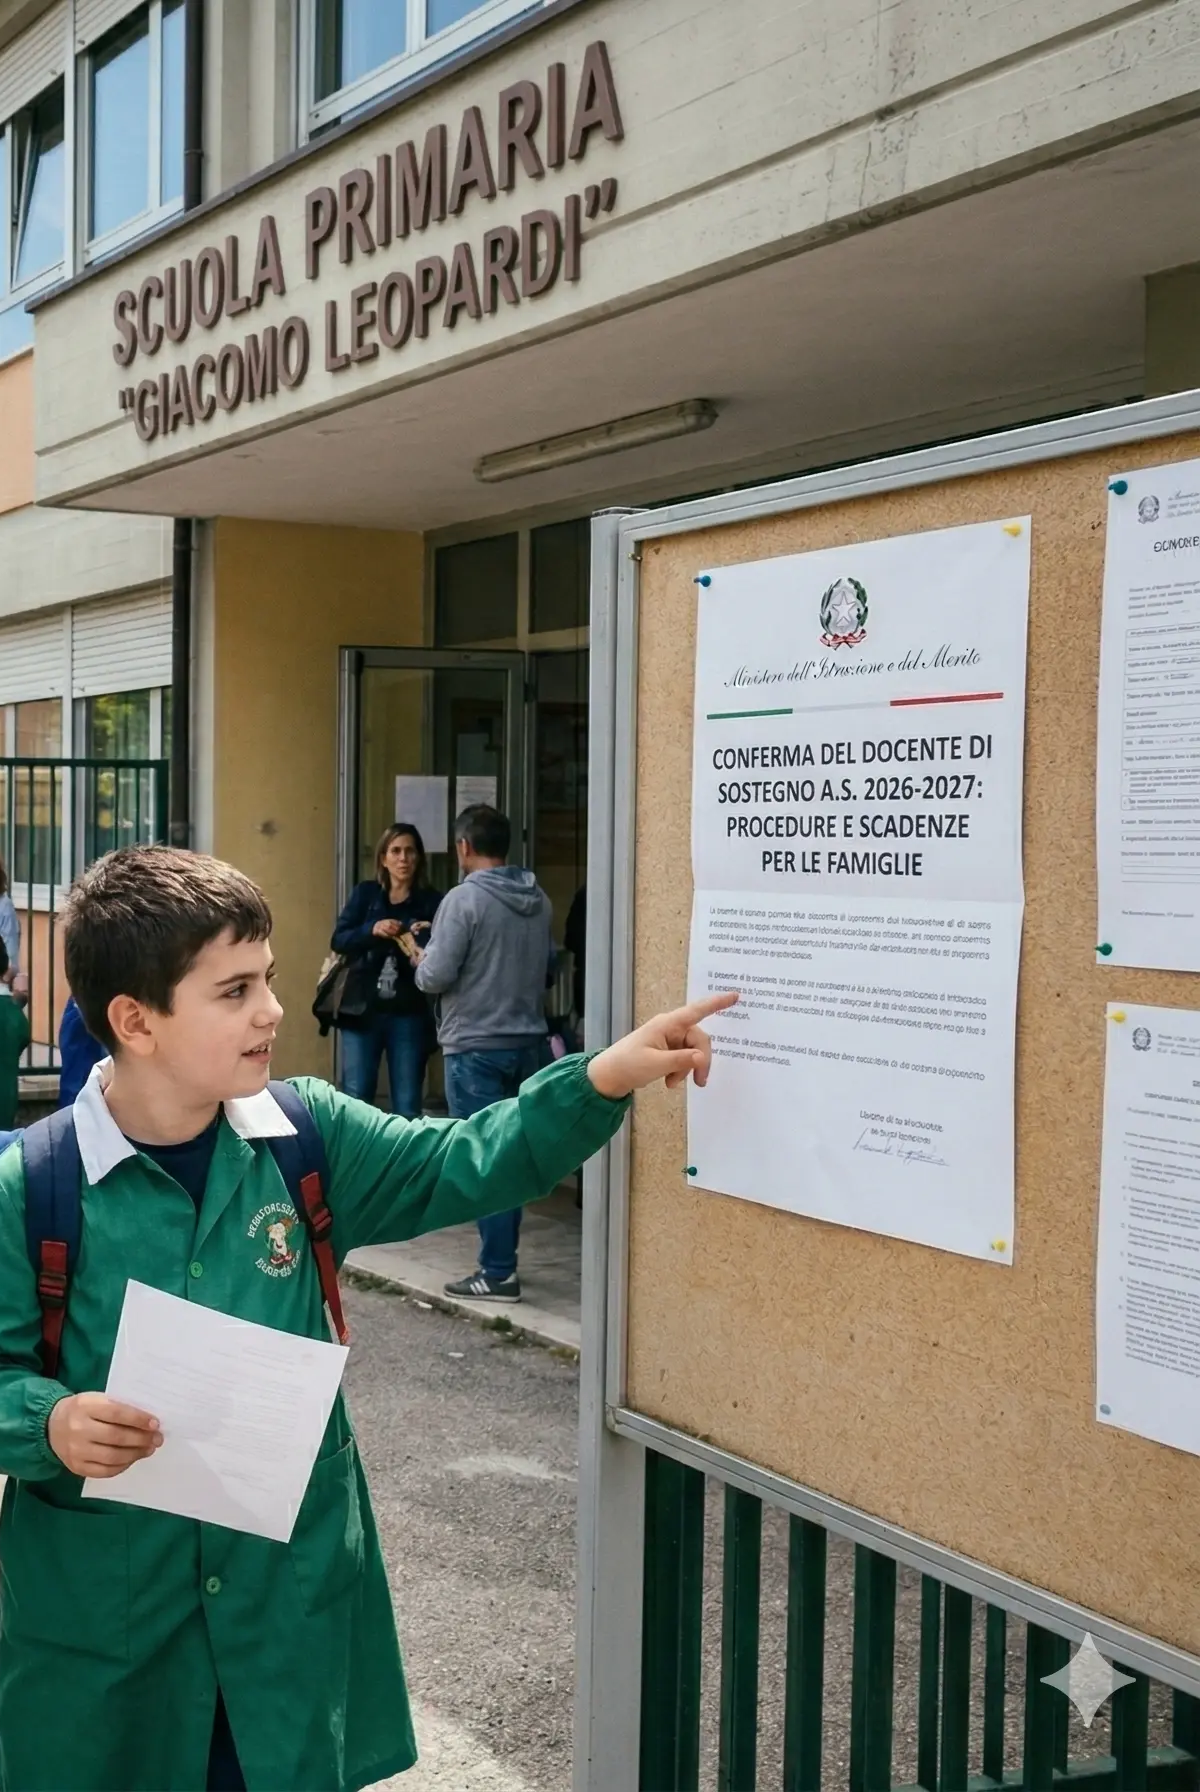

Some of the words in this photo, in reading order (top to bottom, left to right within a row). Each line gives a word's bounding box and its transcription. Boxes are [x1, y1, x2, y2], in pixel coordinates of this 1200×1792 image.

[112, 214, 287, 367] SCUOLA
[304, 39, 624, 281] PRIMARIA
[118, 315, 310, 442] "GIACOMO
[712, 744, 814, 770] CONFERMA
[820, 742, 857, 766] DEL
[862, 736, 962, 763] DOCENTE
[969, 734, 993, 759] DI
[718, 779, 815, 804] SOSTEGNO
[820, 777, 857, 802] A.S.
[864, 774, 983, 801] 2026-2027:
[726, 814, 837, 838] PROCEDURE
[843, 814, 853, 838] E
[859, 813, 970, 839] SCADENZE
[761, 850, 795, 873] PER
[801, 851, 821, 873] LE
[827, 851, 923, 877] FAMIGLIE
